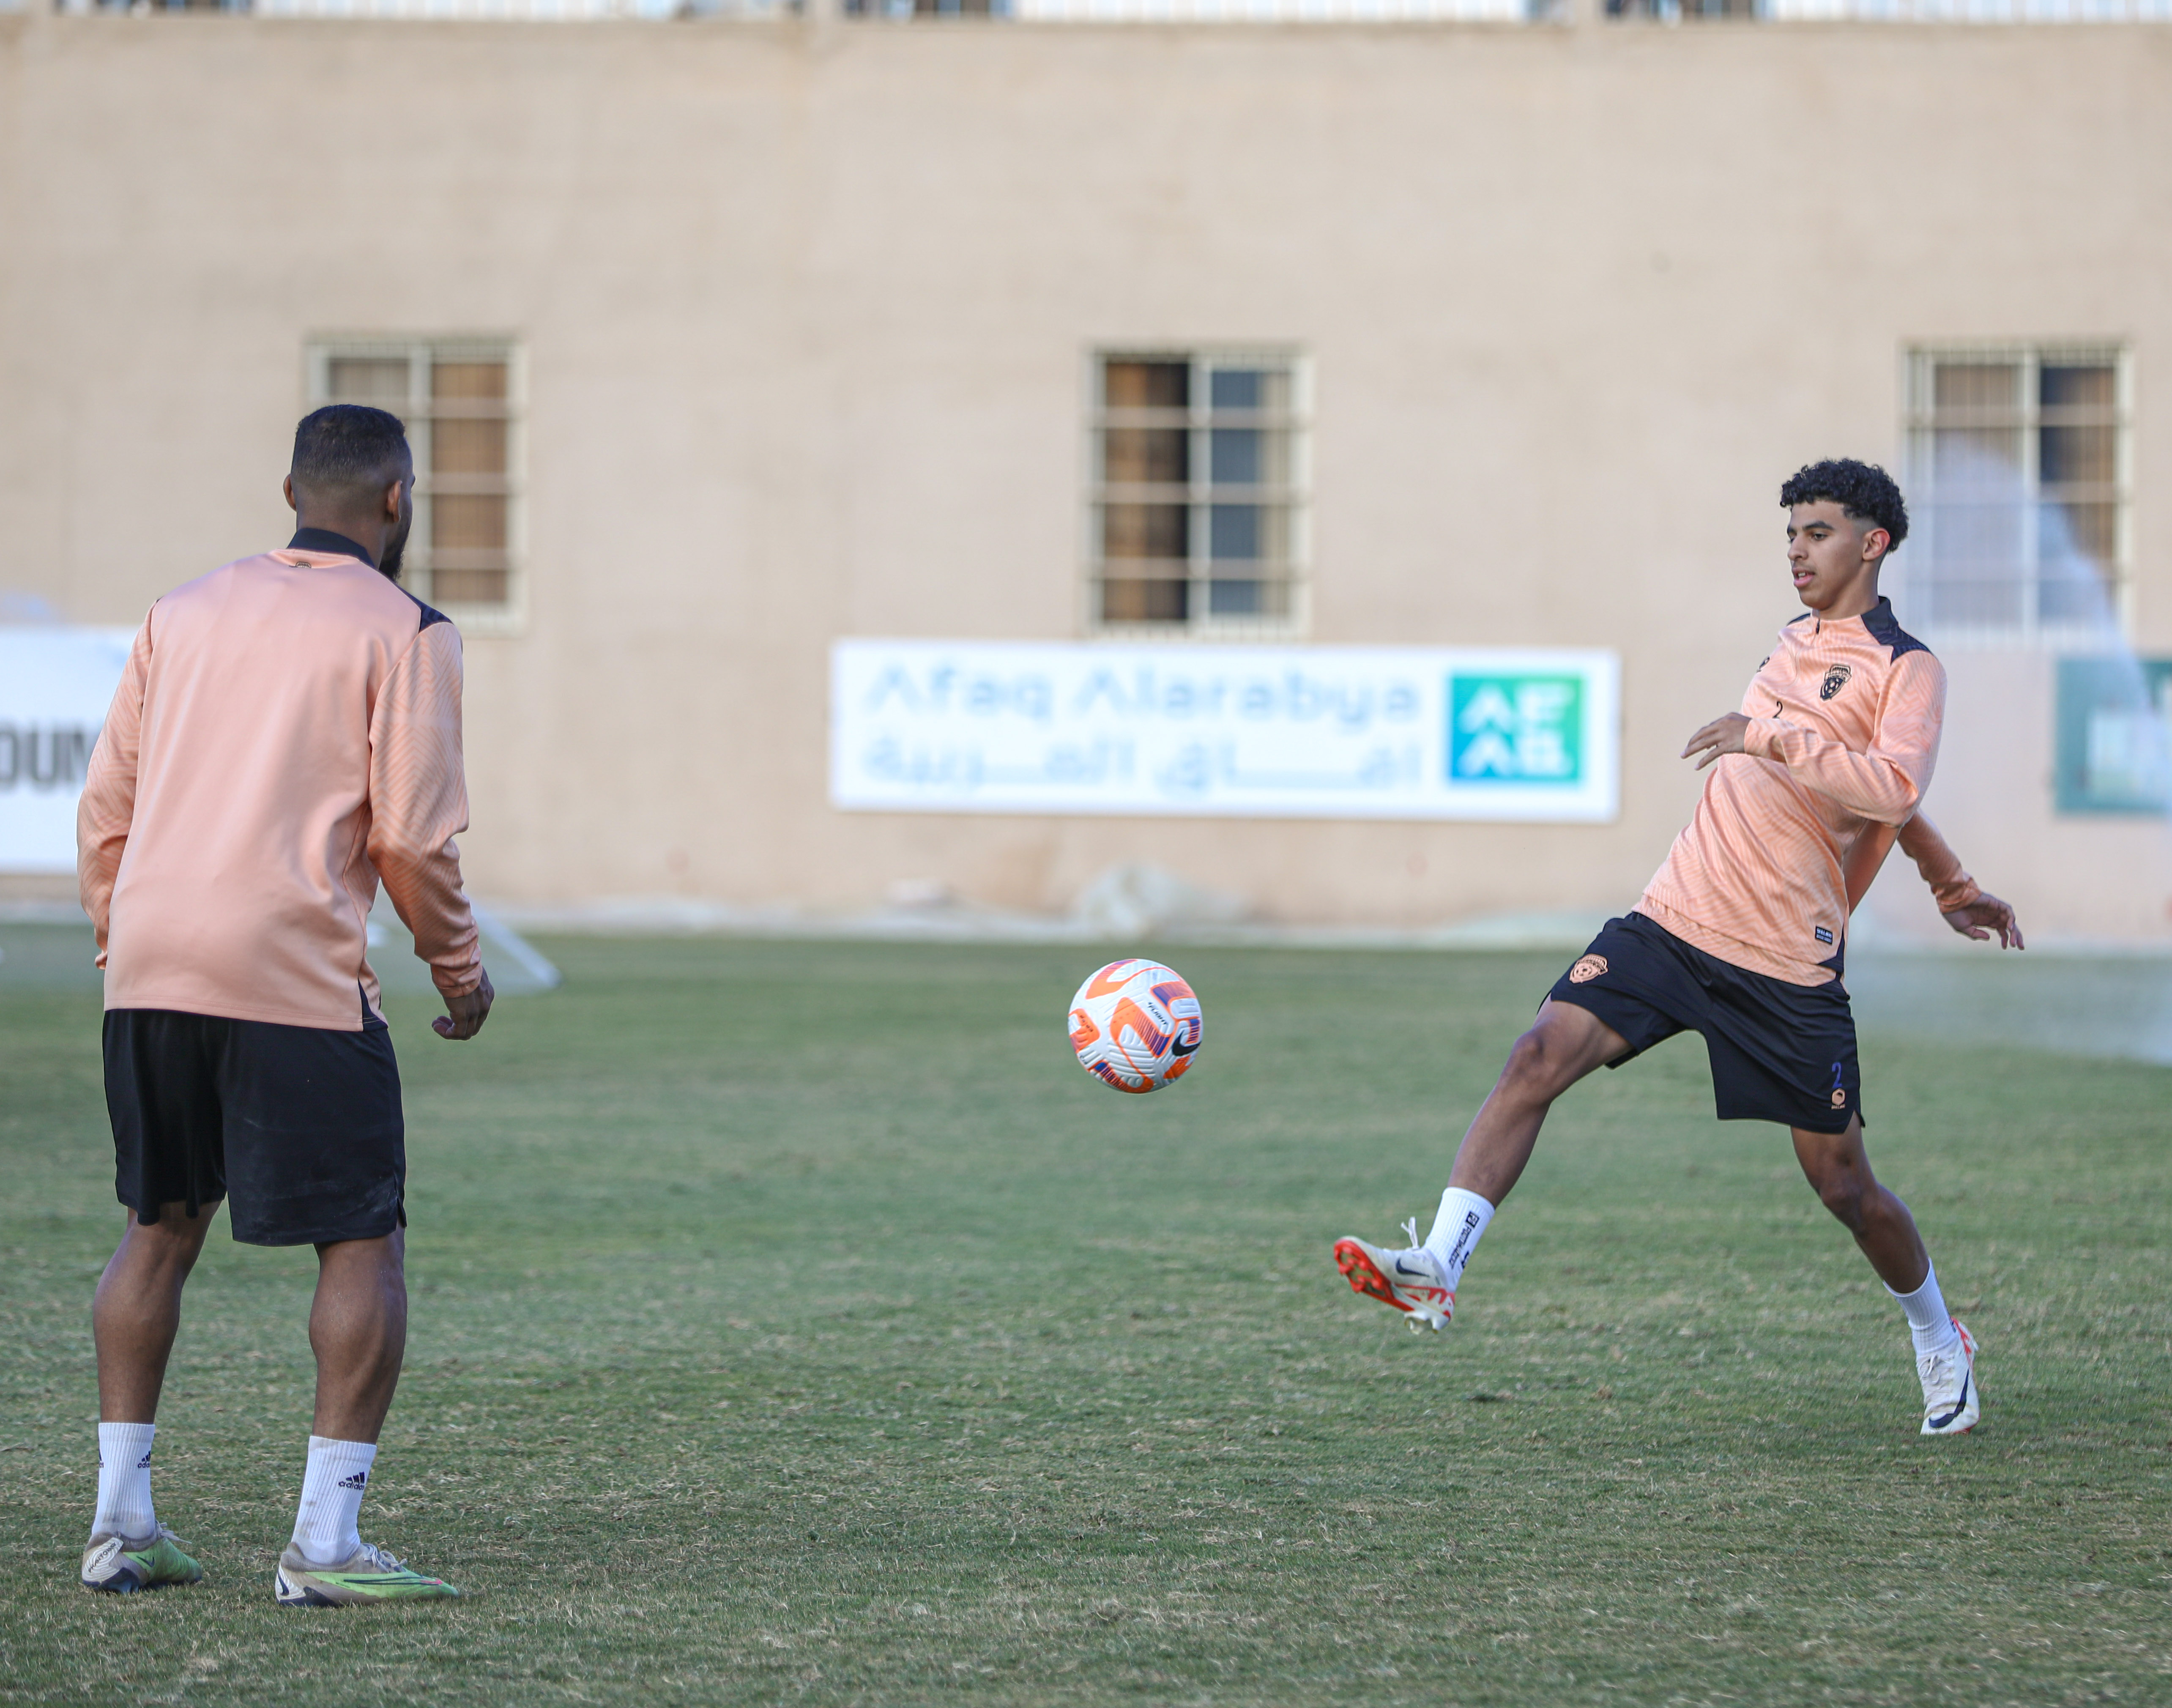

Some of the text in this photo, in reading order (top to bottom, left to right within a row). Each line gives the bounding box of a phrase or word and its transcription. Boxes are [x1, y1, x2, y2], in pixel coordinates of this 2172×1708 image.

[862, 662, 1421, 735] Afaq Alarabya
[1773, 701, 1783, 719] 2
[1147, 1005, 1168, 1025] FLIGHT
[1832, 1062, 1842, 1088] 2
[339, 1481, 365, 1490] adidas
